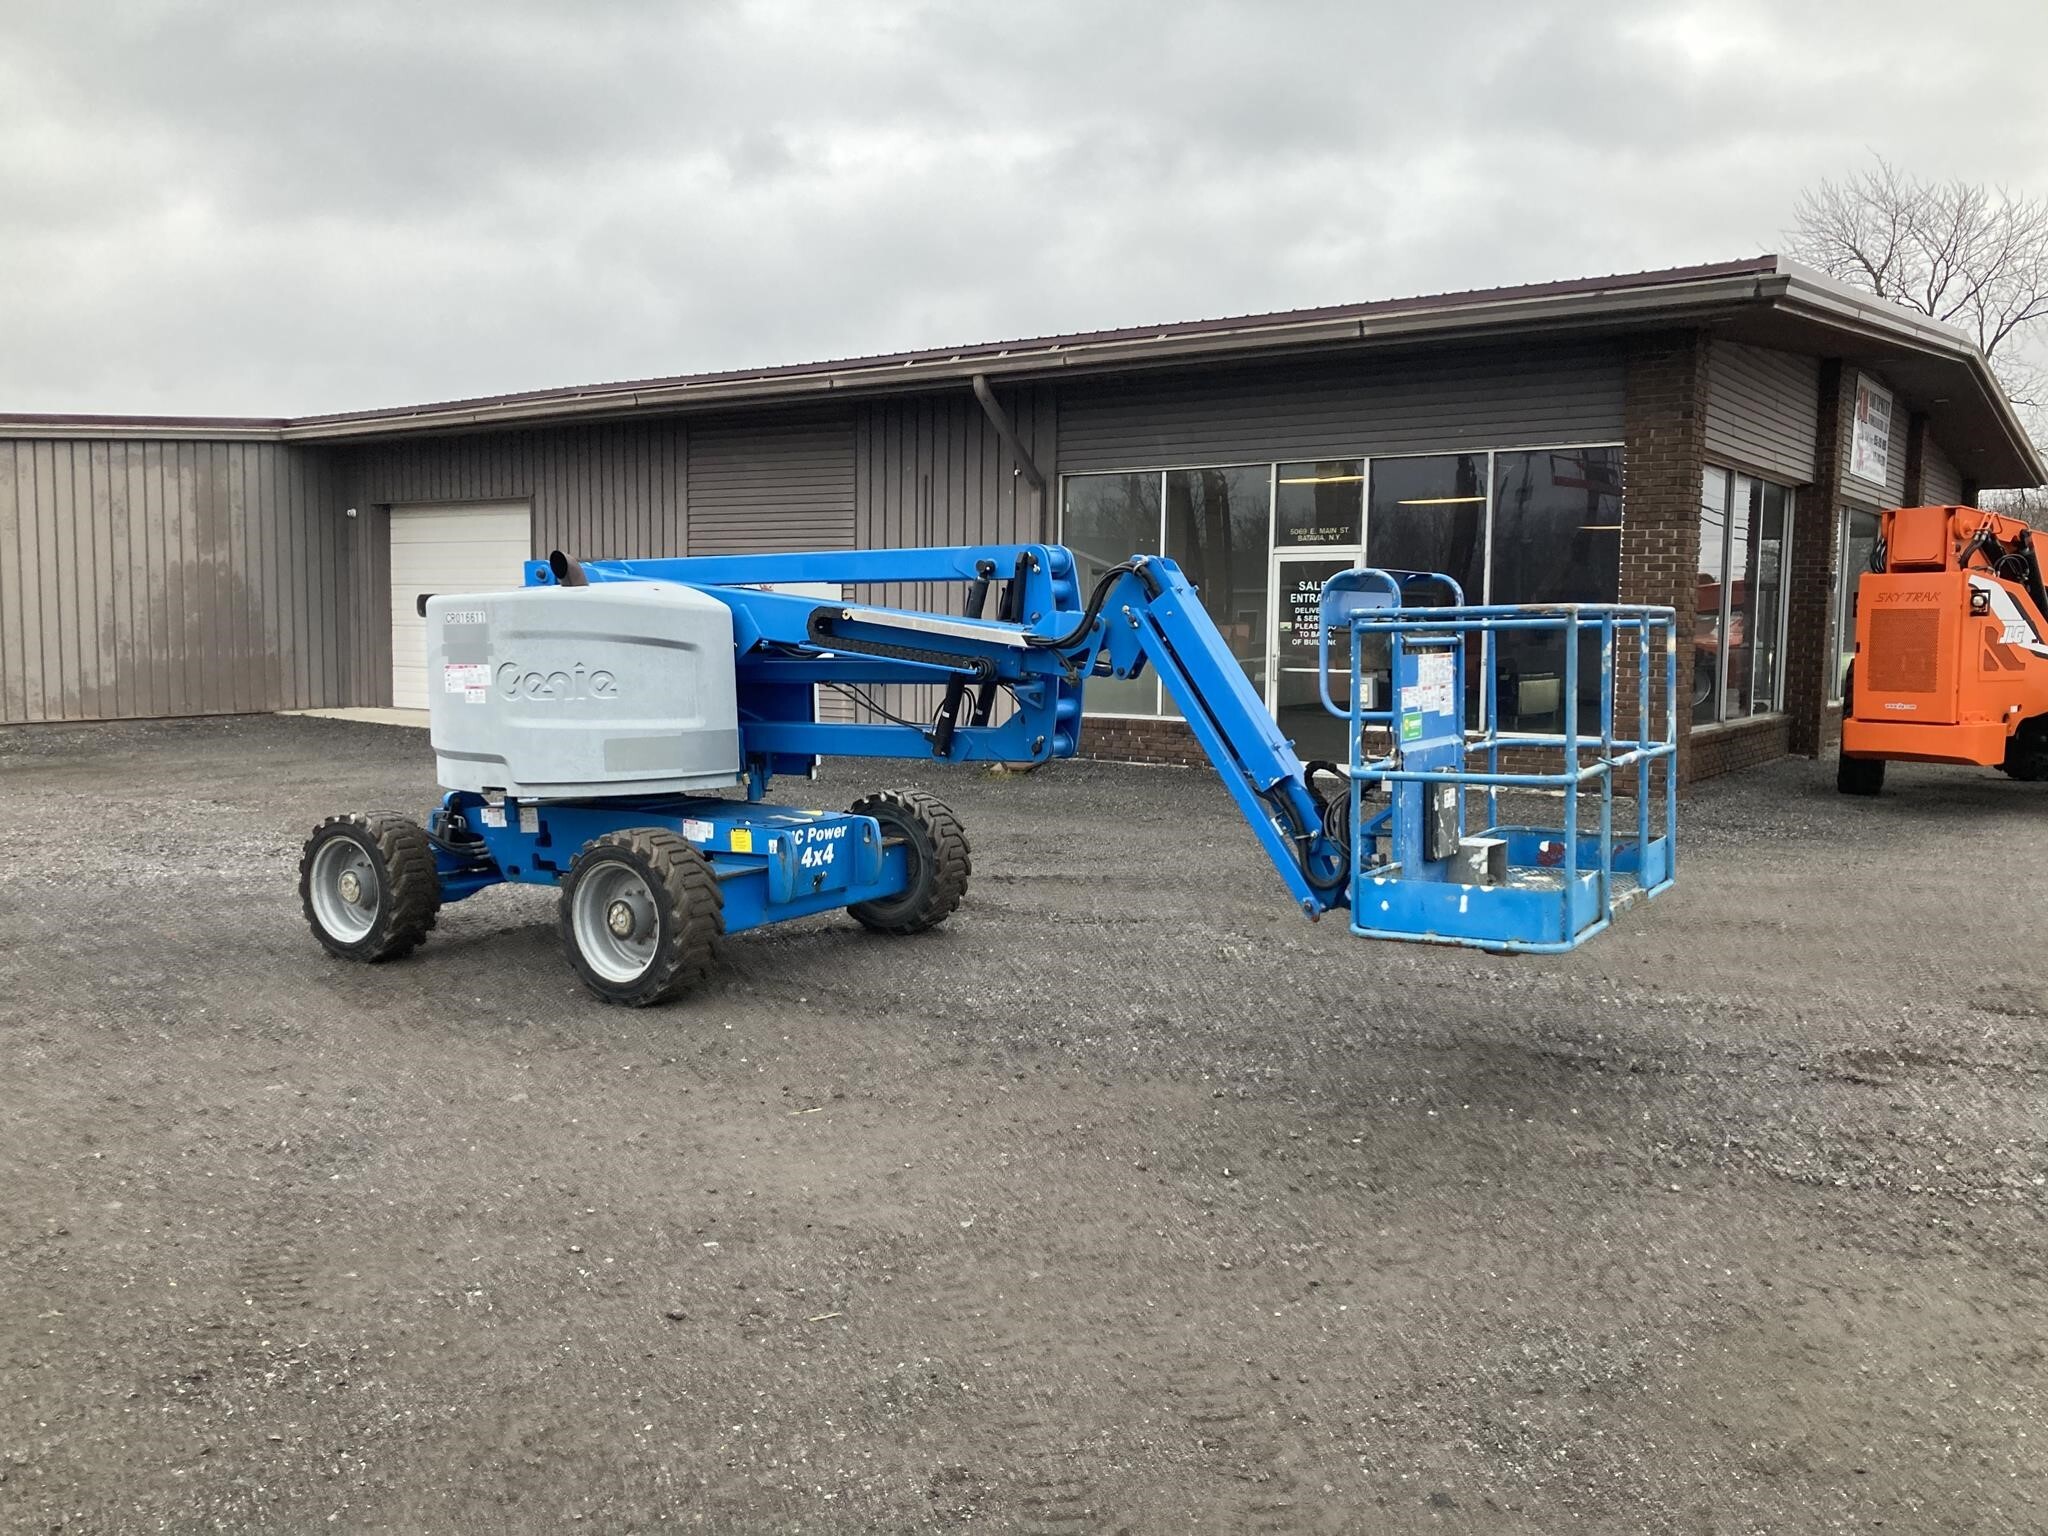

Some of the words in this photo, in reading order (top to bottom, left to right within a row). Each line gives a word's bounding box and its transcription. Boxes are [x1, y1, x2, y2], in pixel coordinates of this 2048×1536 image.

[496, 661, 619, 702] Genie
[807, 825, 848, 843] Power
[801, 842, 834, 868] 4x4
